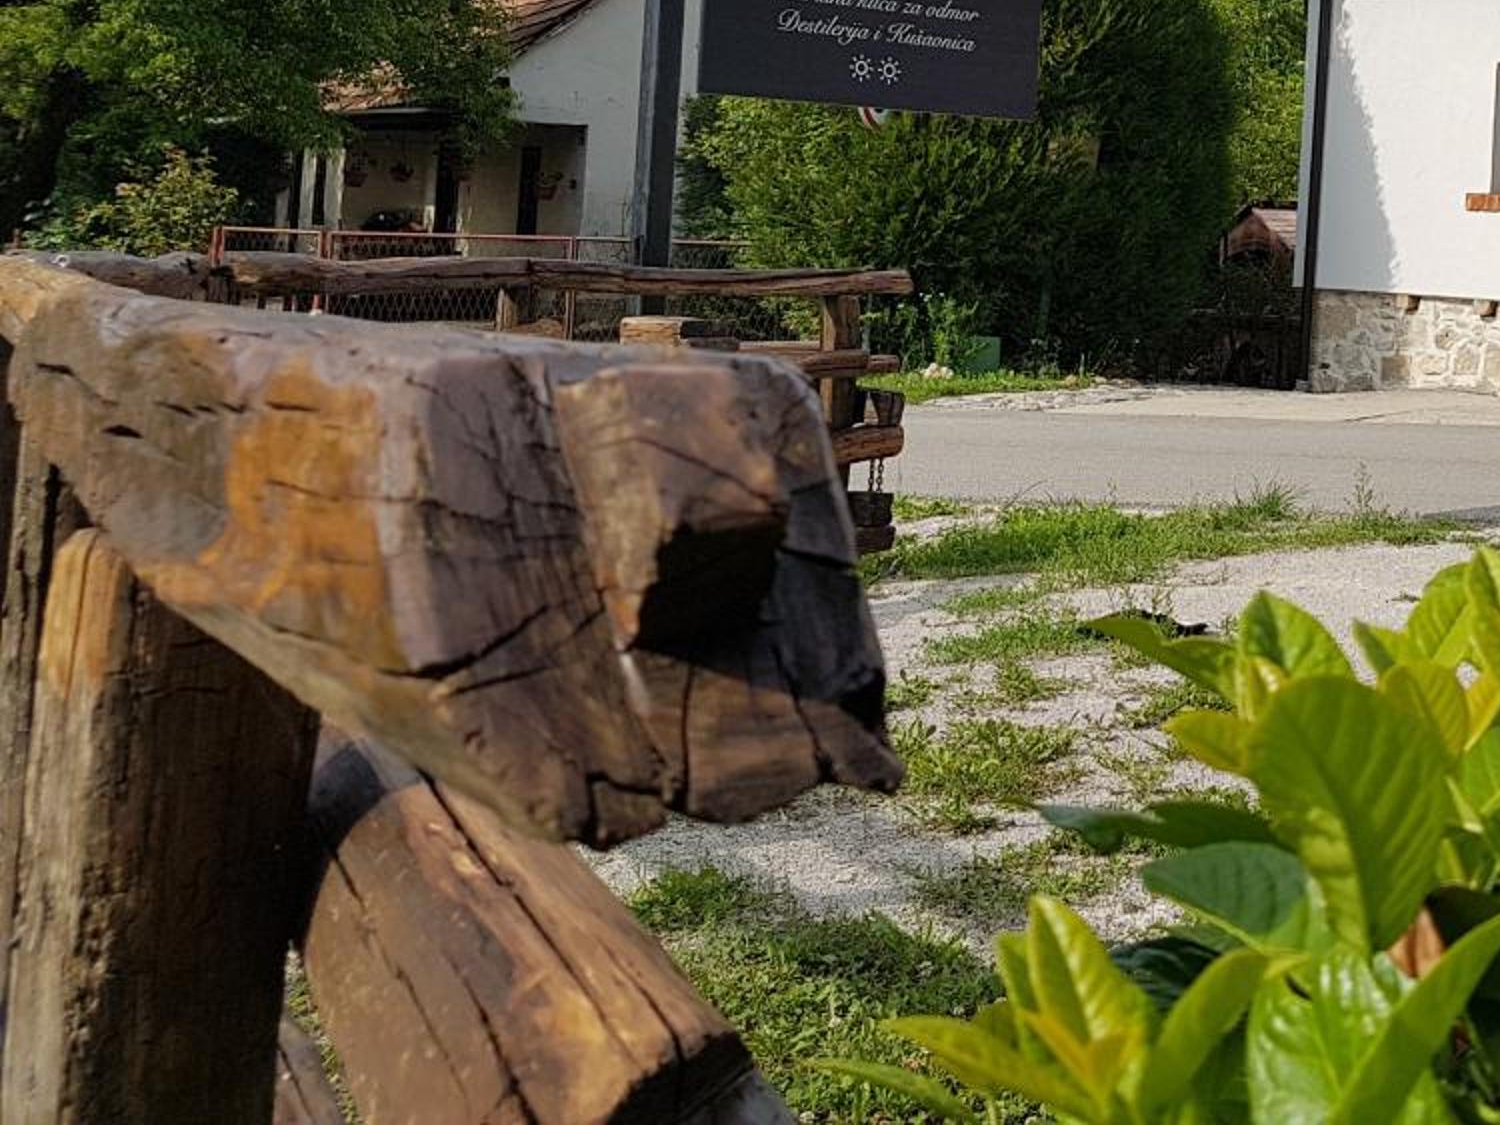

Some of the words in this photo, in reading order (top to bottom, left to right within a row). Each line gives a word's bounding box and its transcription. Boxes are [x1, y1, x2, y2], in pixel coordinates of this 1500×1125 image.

[903, 2, 922, 15] za
[925, 0, 980, 22] odmor
[777, 8, 870, 46] Destilerija
[873, 25, 883, 41] i
[885, 22, 977, 52] Kušaonica
